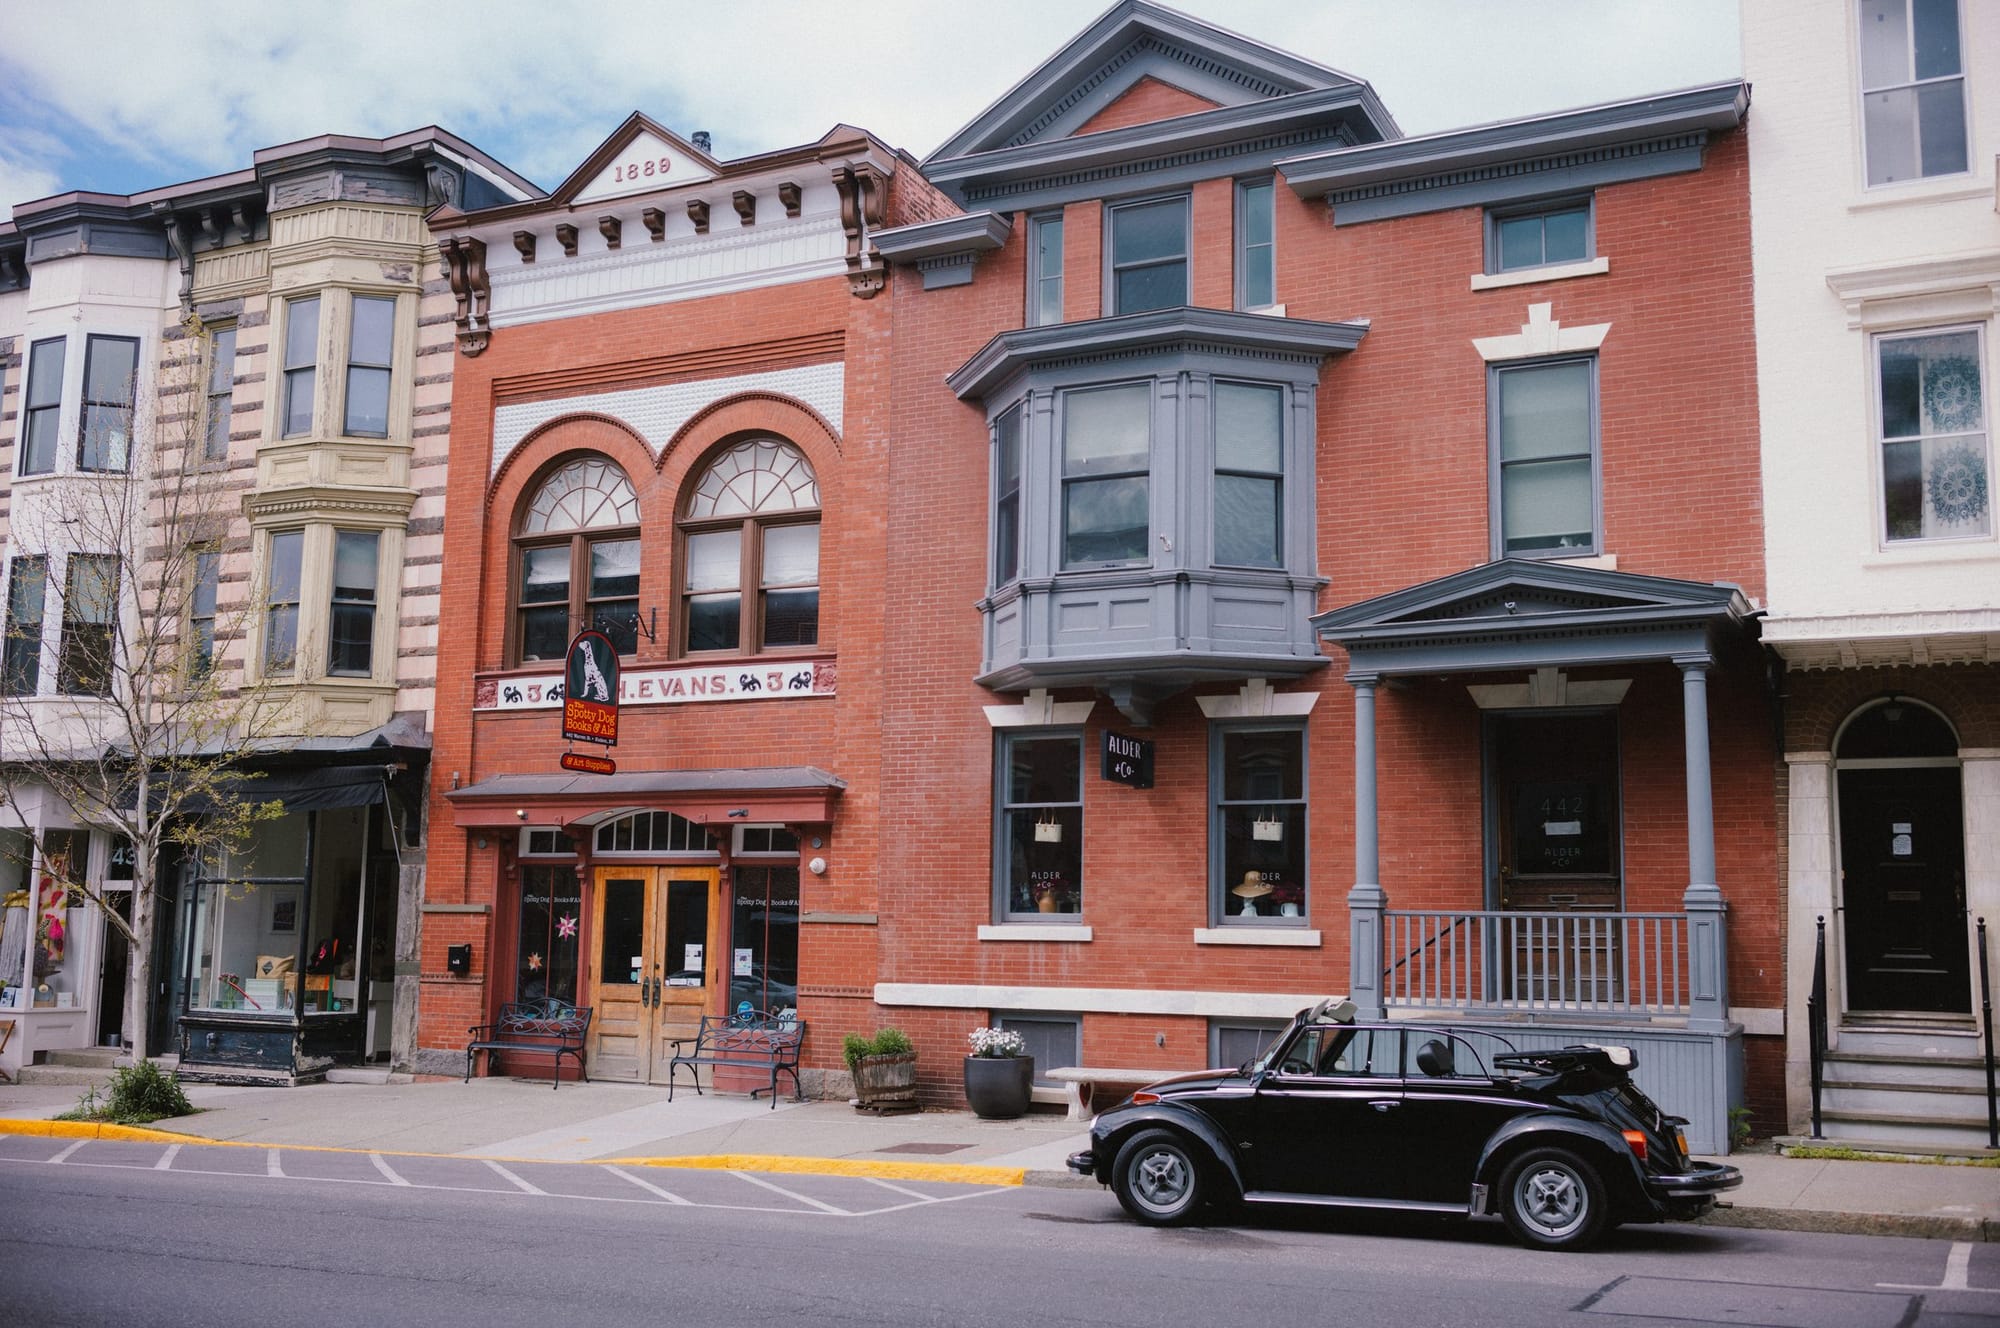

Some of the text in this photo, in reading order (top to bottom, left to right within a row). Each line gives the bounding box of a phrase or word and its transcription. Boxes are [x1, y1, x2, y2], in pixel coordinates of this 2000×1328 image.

[615, 157, 671, 182] 1889
[526, 684, 542, 703] 3
[766, 672, 783, 692] 3
[567, 703, 616, 726] Spotty Dog
[574, 701, 585, 709] The
[566, 718, 615, 736] Books & Ale
[1109, 735, 1141, 759] ALDER
[573, 758, 584, 767] Art
[585, 760, 611, 771] Supplies
[1541, 796, 1584, 816] 442
[1544, 847, 1582, 857] ALDER
[1031, 871, 1061, 880] ALDER
